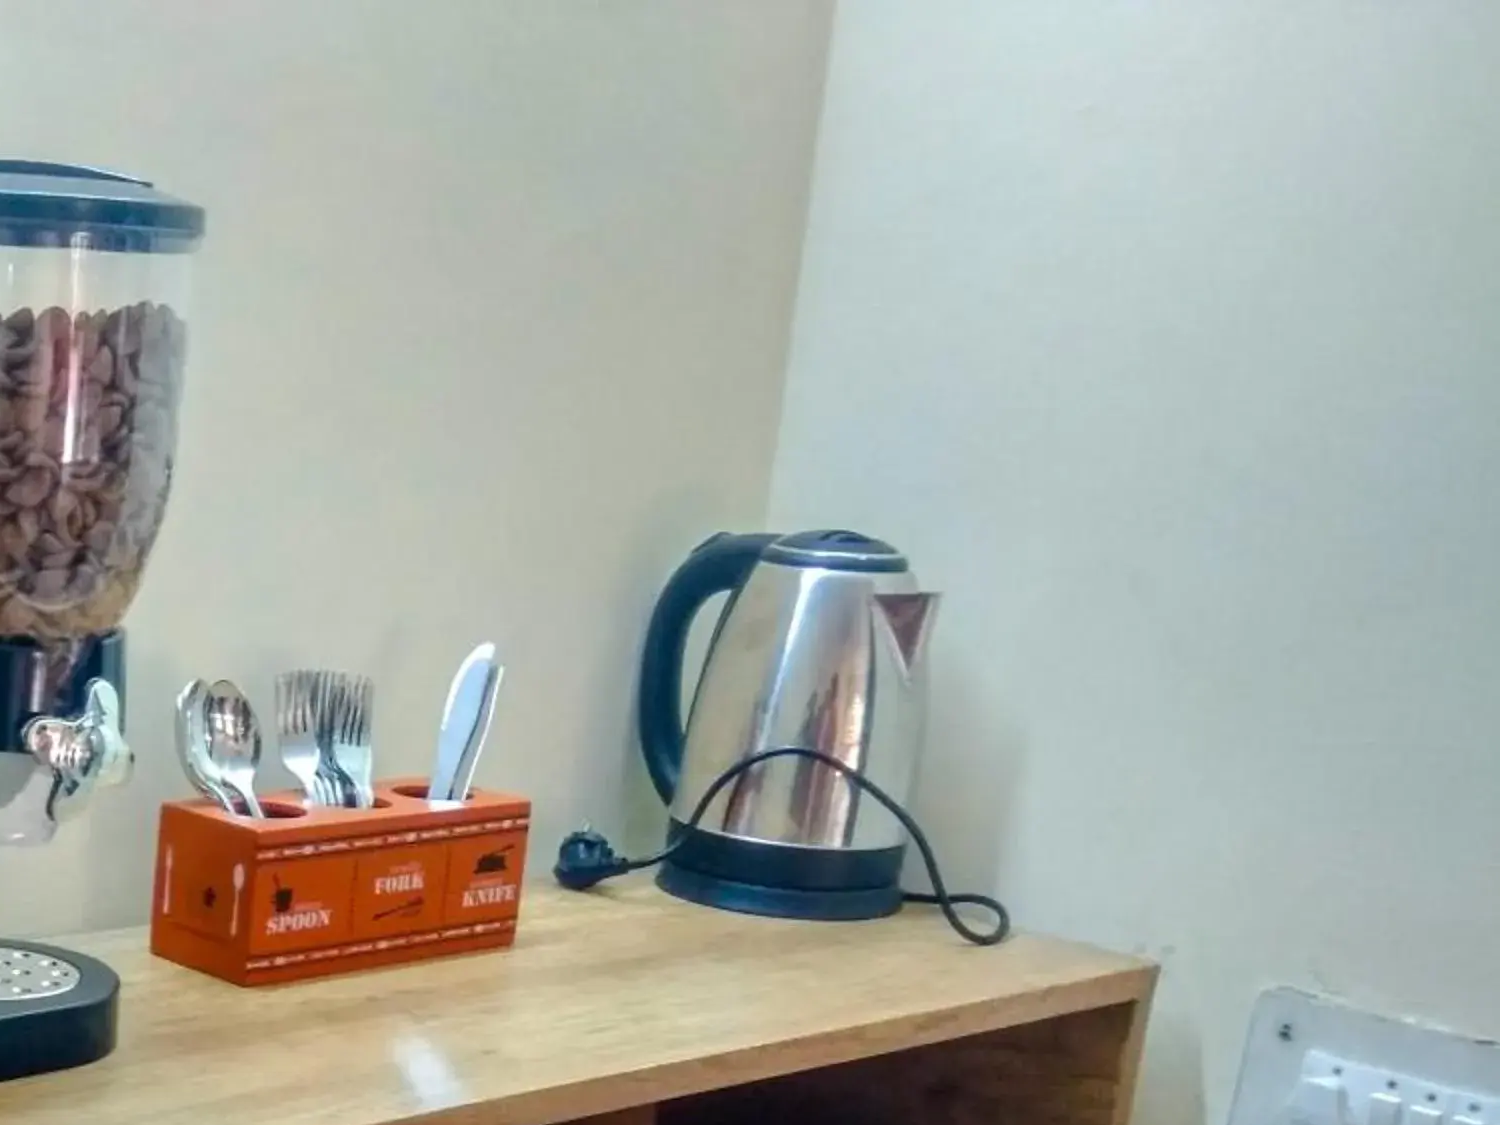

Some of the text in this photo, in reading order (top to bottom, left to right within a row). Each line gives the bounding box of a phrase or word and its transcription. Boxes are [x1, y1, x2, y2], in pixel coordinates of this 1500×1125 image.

[374, 871, 424, 894] FORK
[461, 884, 517, 907] KNIFE
[266, 909, 332, 935] SPOON
